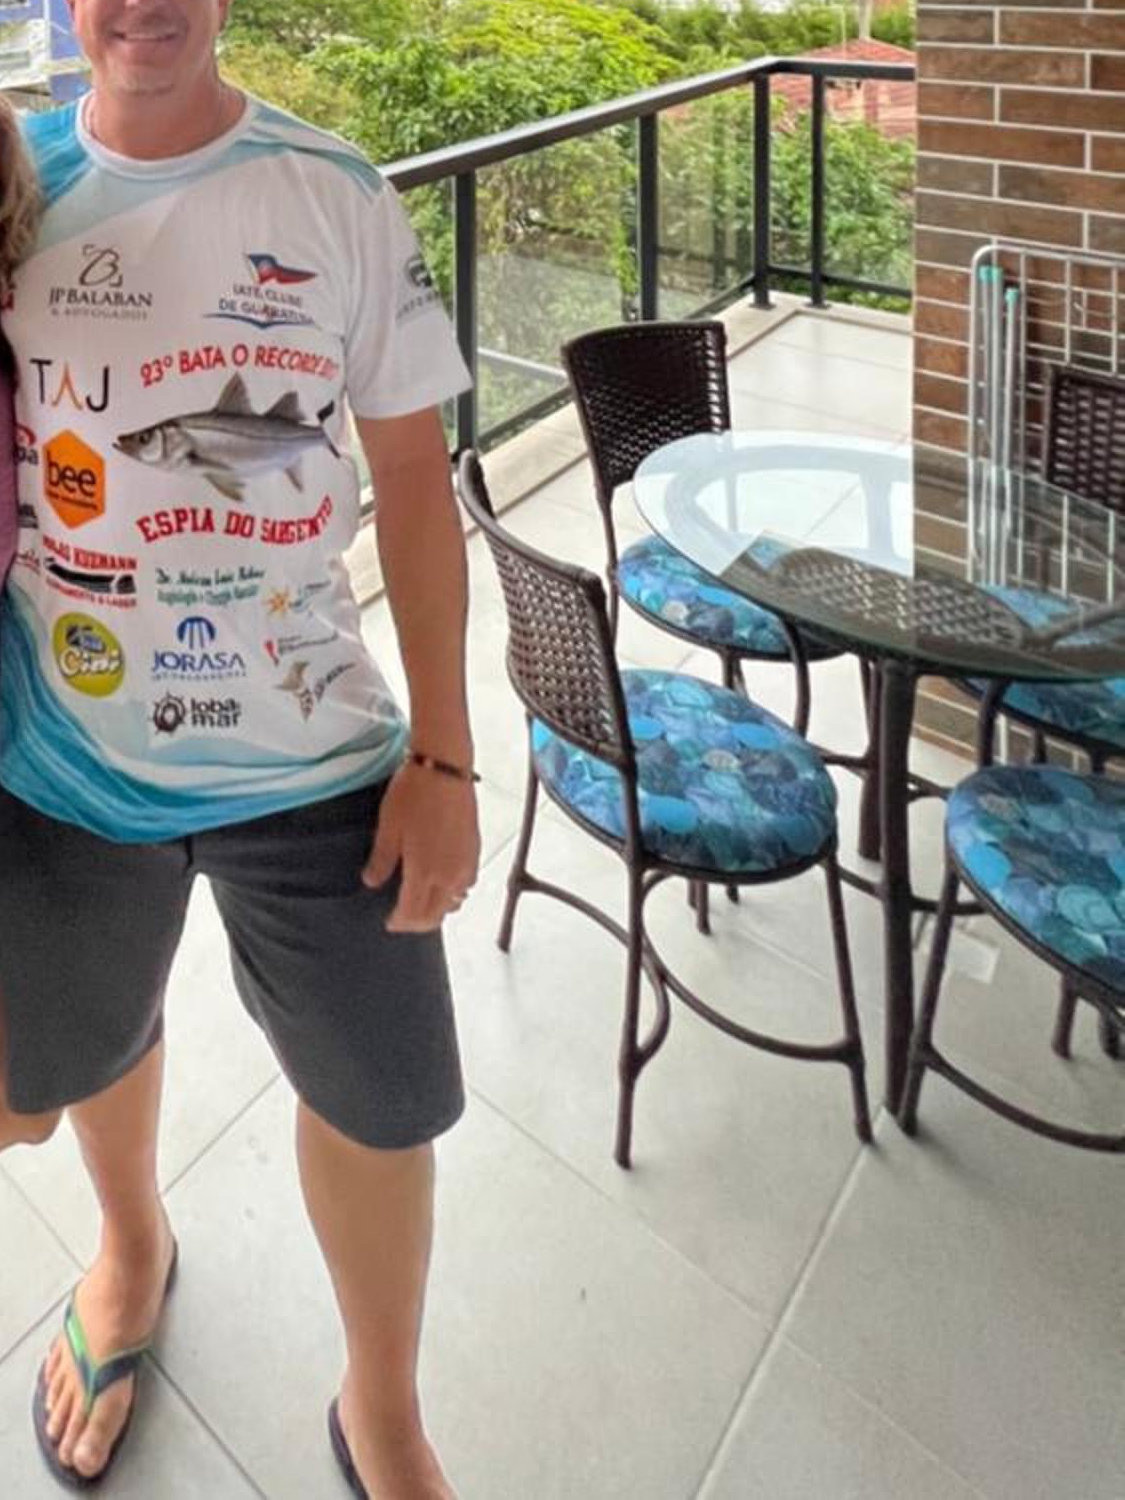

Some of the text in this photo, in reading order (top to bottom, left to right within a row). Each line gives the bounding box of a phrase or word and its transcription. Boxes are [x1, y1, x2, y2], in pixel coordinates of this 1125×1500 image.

[218, 298, 236, 312] DE
[178, 345, 225, 374] BATA
[232, 343, 249, 366] O
[46, 449, 96, 497] bee
[136, 507, 215, 543] ESPIA
[224, 510, 254, 538] DO
[152, 650, 245, 673] JORASA
